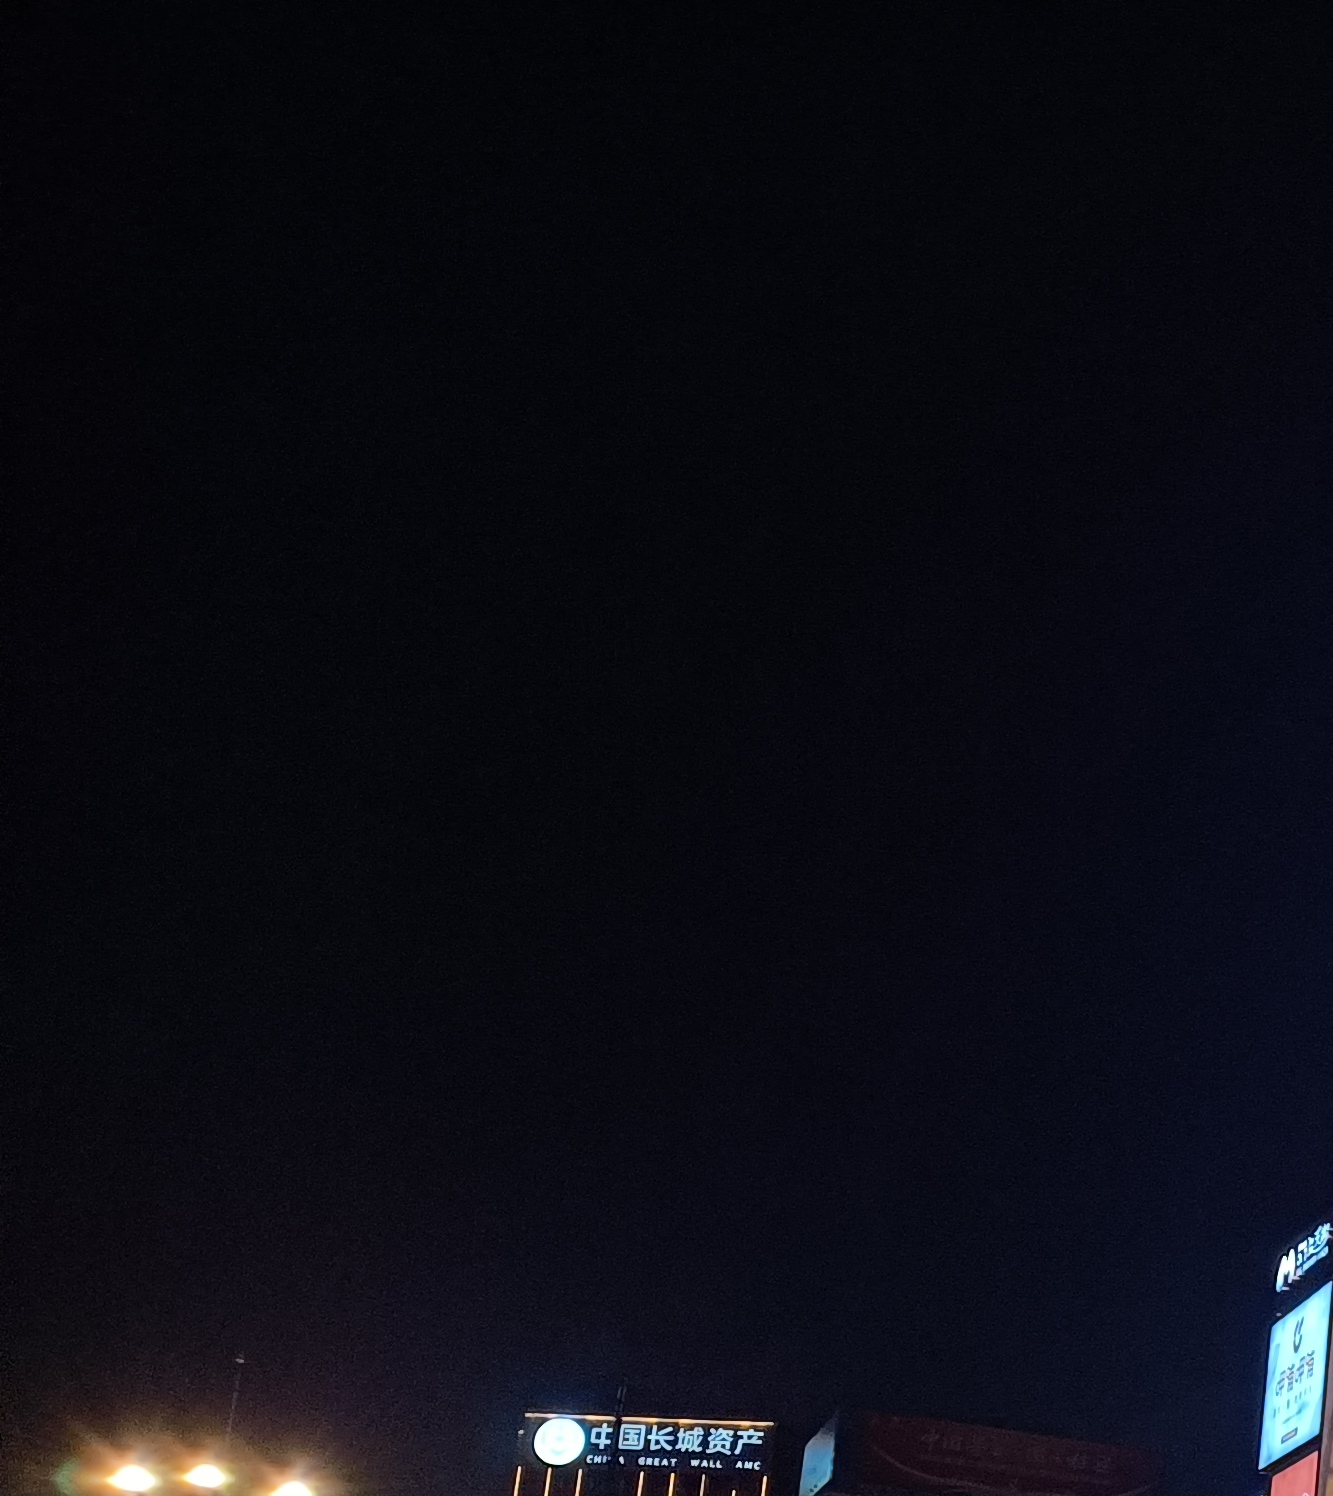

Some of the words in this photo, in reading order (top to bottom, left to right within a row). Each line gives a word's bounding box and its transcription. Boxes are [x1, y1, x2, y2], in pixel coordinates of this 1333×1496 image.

[589, 1422, 766, 1456] 中国长城资产
[637, 1456, 678, 1467] GREAT
[690, 1458, 723, 1469] WALL
[735, 1460, 762, 1471] AMC
